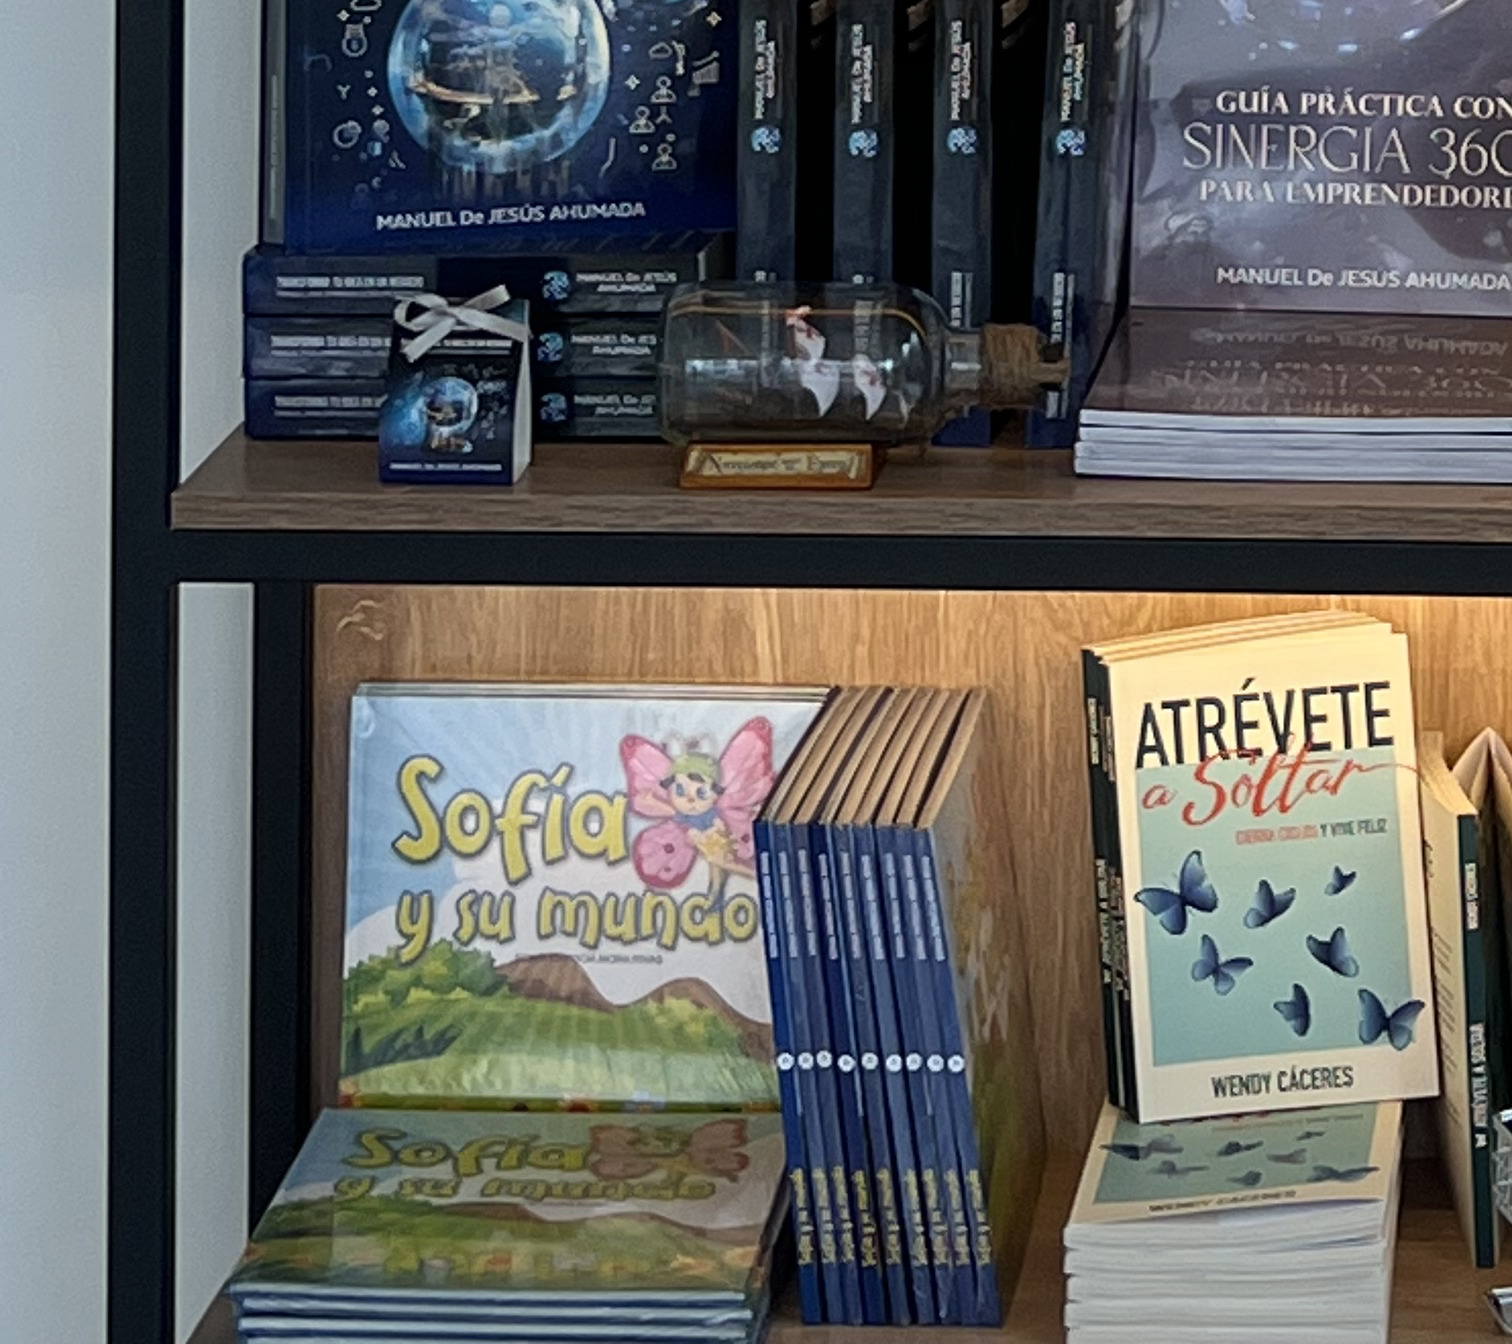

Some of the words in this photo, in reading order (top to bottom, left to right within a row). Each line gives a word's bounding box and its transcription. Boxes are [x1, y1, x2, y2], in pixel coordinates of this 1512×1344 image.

[1216, 85, 1289, 115] GUÍA
[1300, 87, 1443, 117] PRÁCTICA
[1183, 122, 1411, 174] SINERGIA
[376, 211, 456, 230] MANUEL
[461, 210, 484, 226] De
[488, 202, 546, 225] JESÚS
[550, 201, 646, 221] AHUMADA
[1200, 179, 1276, 203] PARA
[1135, 677, 1395, 770] ATRÉVETE
[1141, 783, 1176, 810] a
[1182, 737, 1415, 826] Soltar
[392, 754, 629, 887] Sofía
[396, 888, 434, 967] y
[454, 888, 516, 947] su
[538, 887, 757, 950] mundo
[1211, 1073, 1272, 1098] WENDY
[1276, 1064, 1355, 1094] CÁCERES
